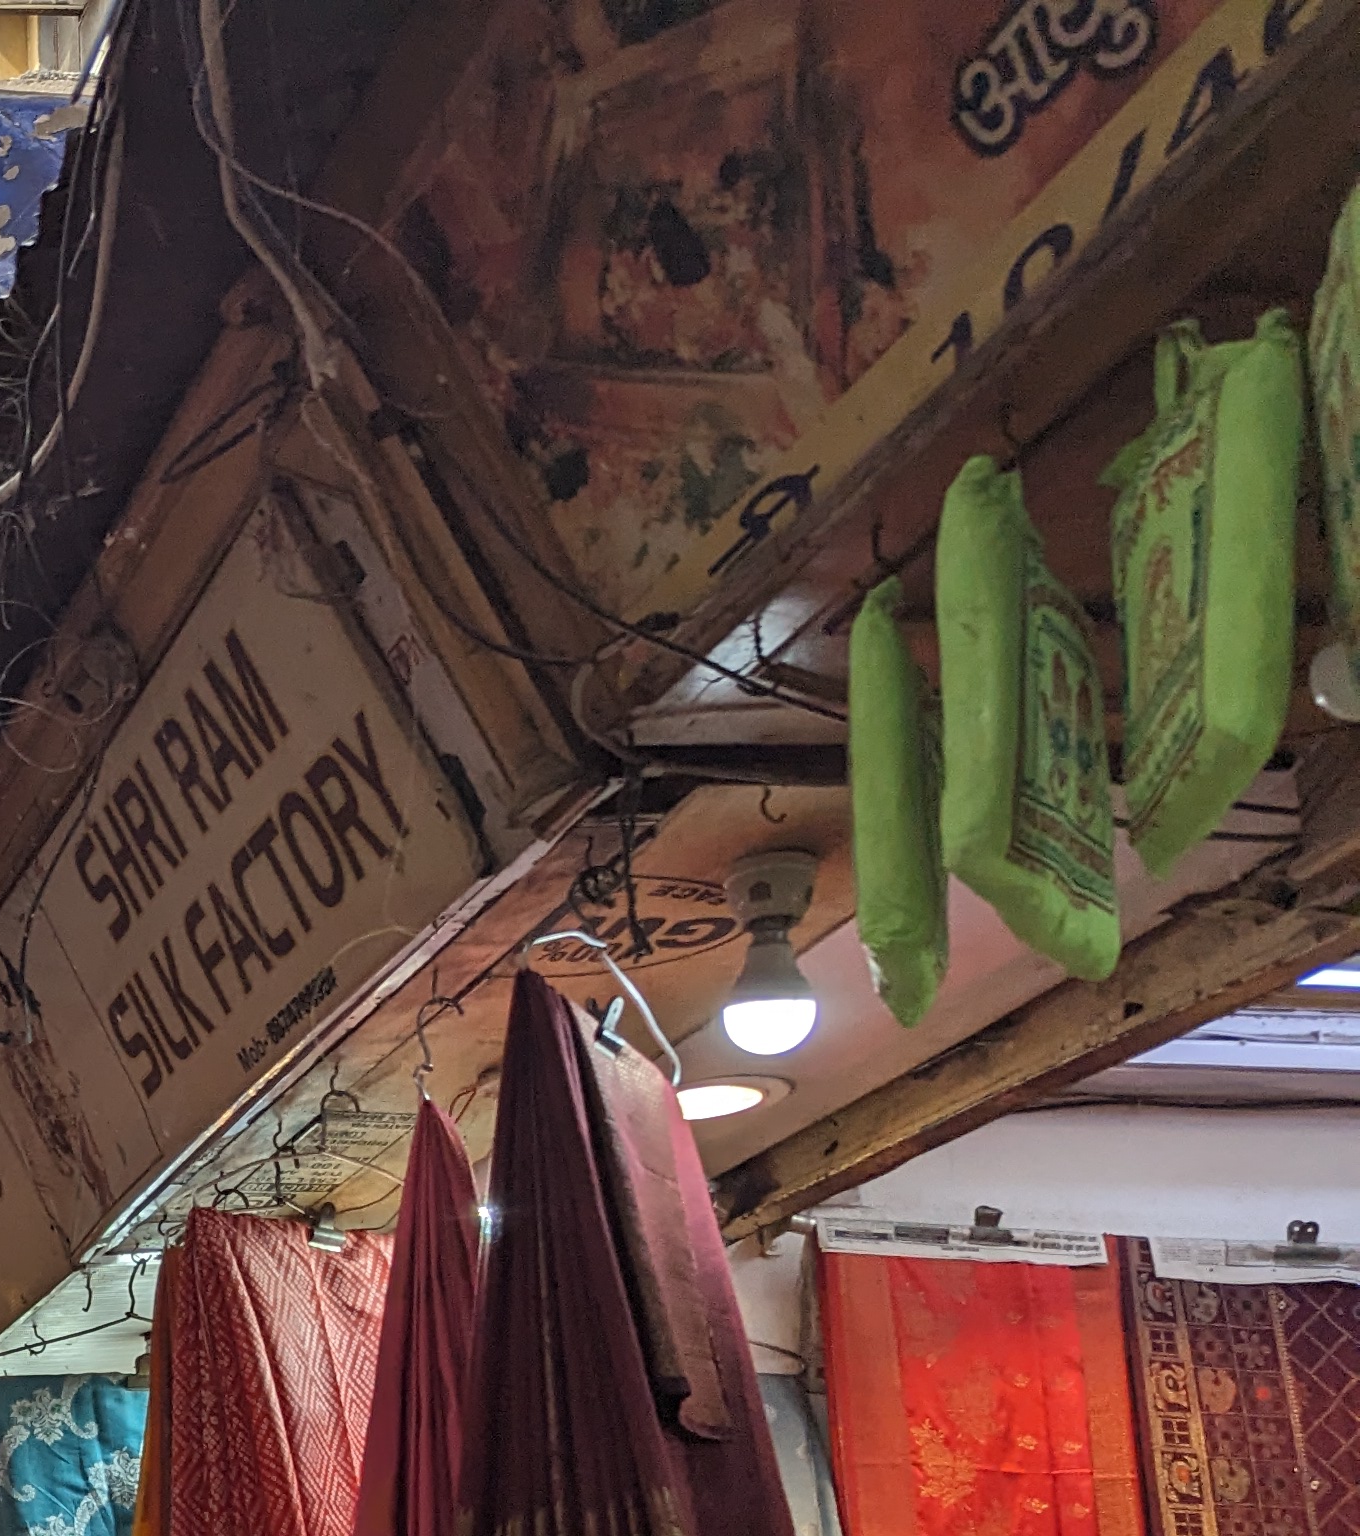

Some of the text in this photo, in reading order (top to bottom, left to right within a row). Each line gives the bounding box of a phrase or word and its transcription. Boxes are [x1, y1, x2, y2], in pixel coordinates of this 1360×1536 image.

[76, 628, 290, 942] SHRI RAM
[107, 936, 215, 1099] SILK
[181, 709, 405, 1010] FACTORY
